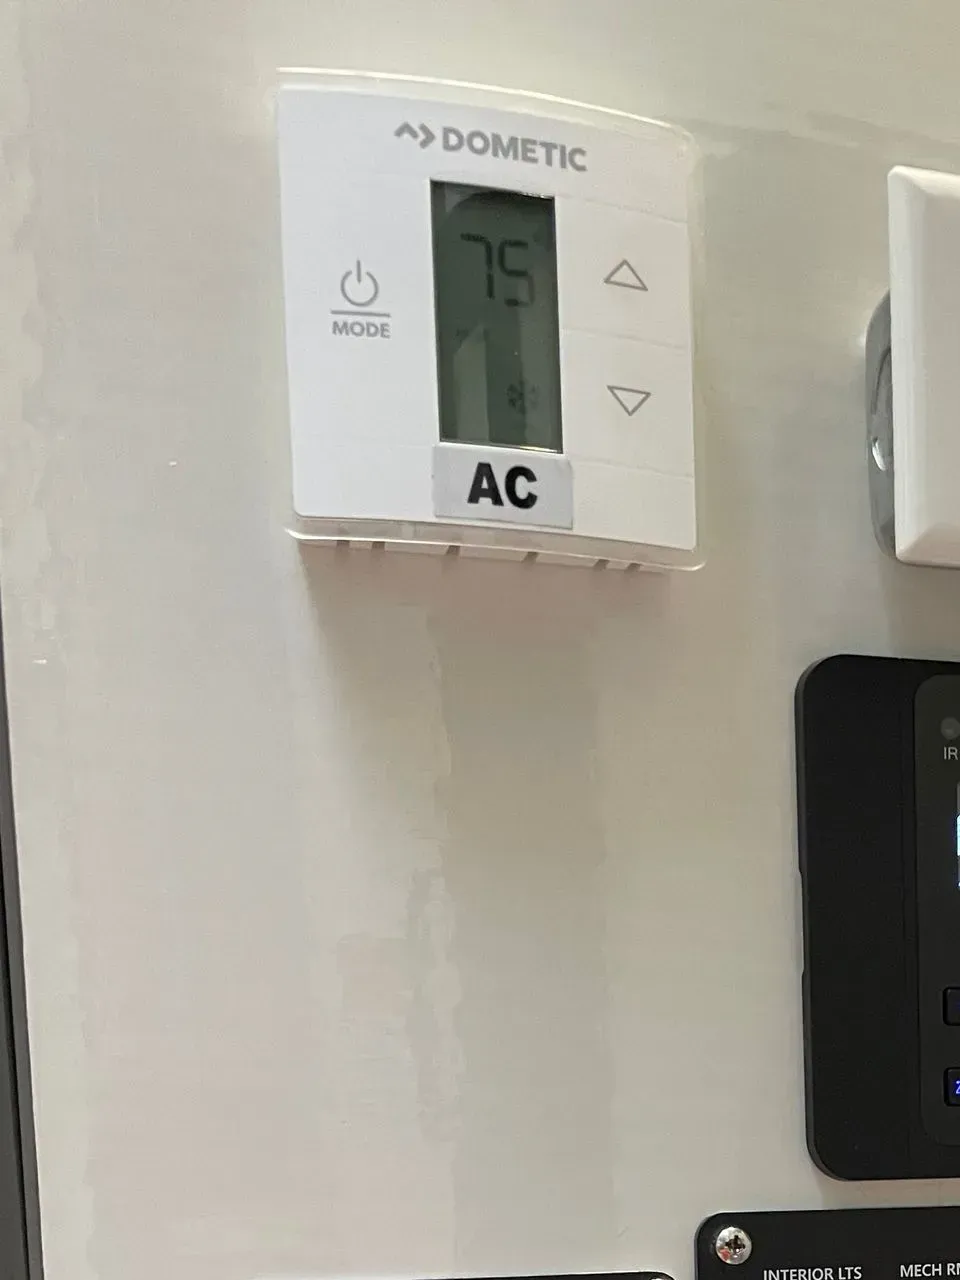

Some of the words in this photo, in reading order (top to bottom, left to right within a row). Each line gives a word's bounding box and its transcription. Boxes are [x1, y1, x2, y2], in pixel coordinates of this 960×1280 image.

[443, 126, 588, 172] DOMETIC
[461, 233, 535, 308] 75
[332, 320, 390, 339] MODE
[467, 462, 538, 508] AC
[944, 747, 958, 760] IR
[838, 1266, 862, 1280] LTS
[900, 1263, 942, 1278] MECH
